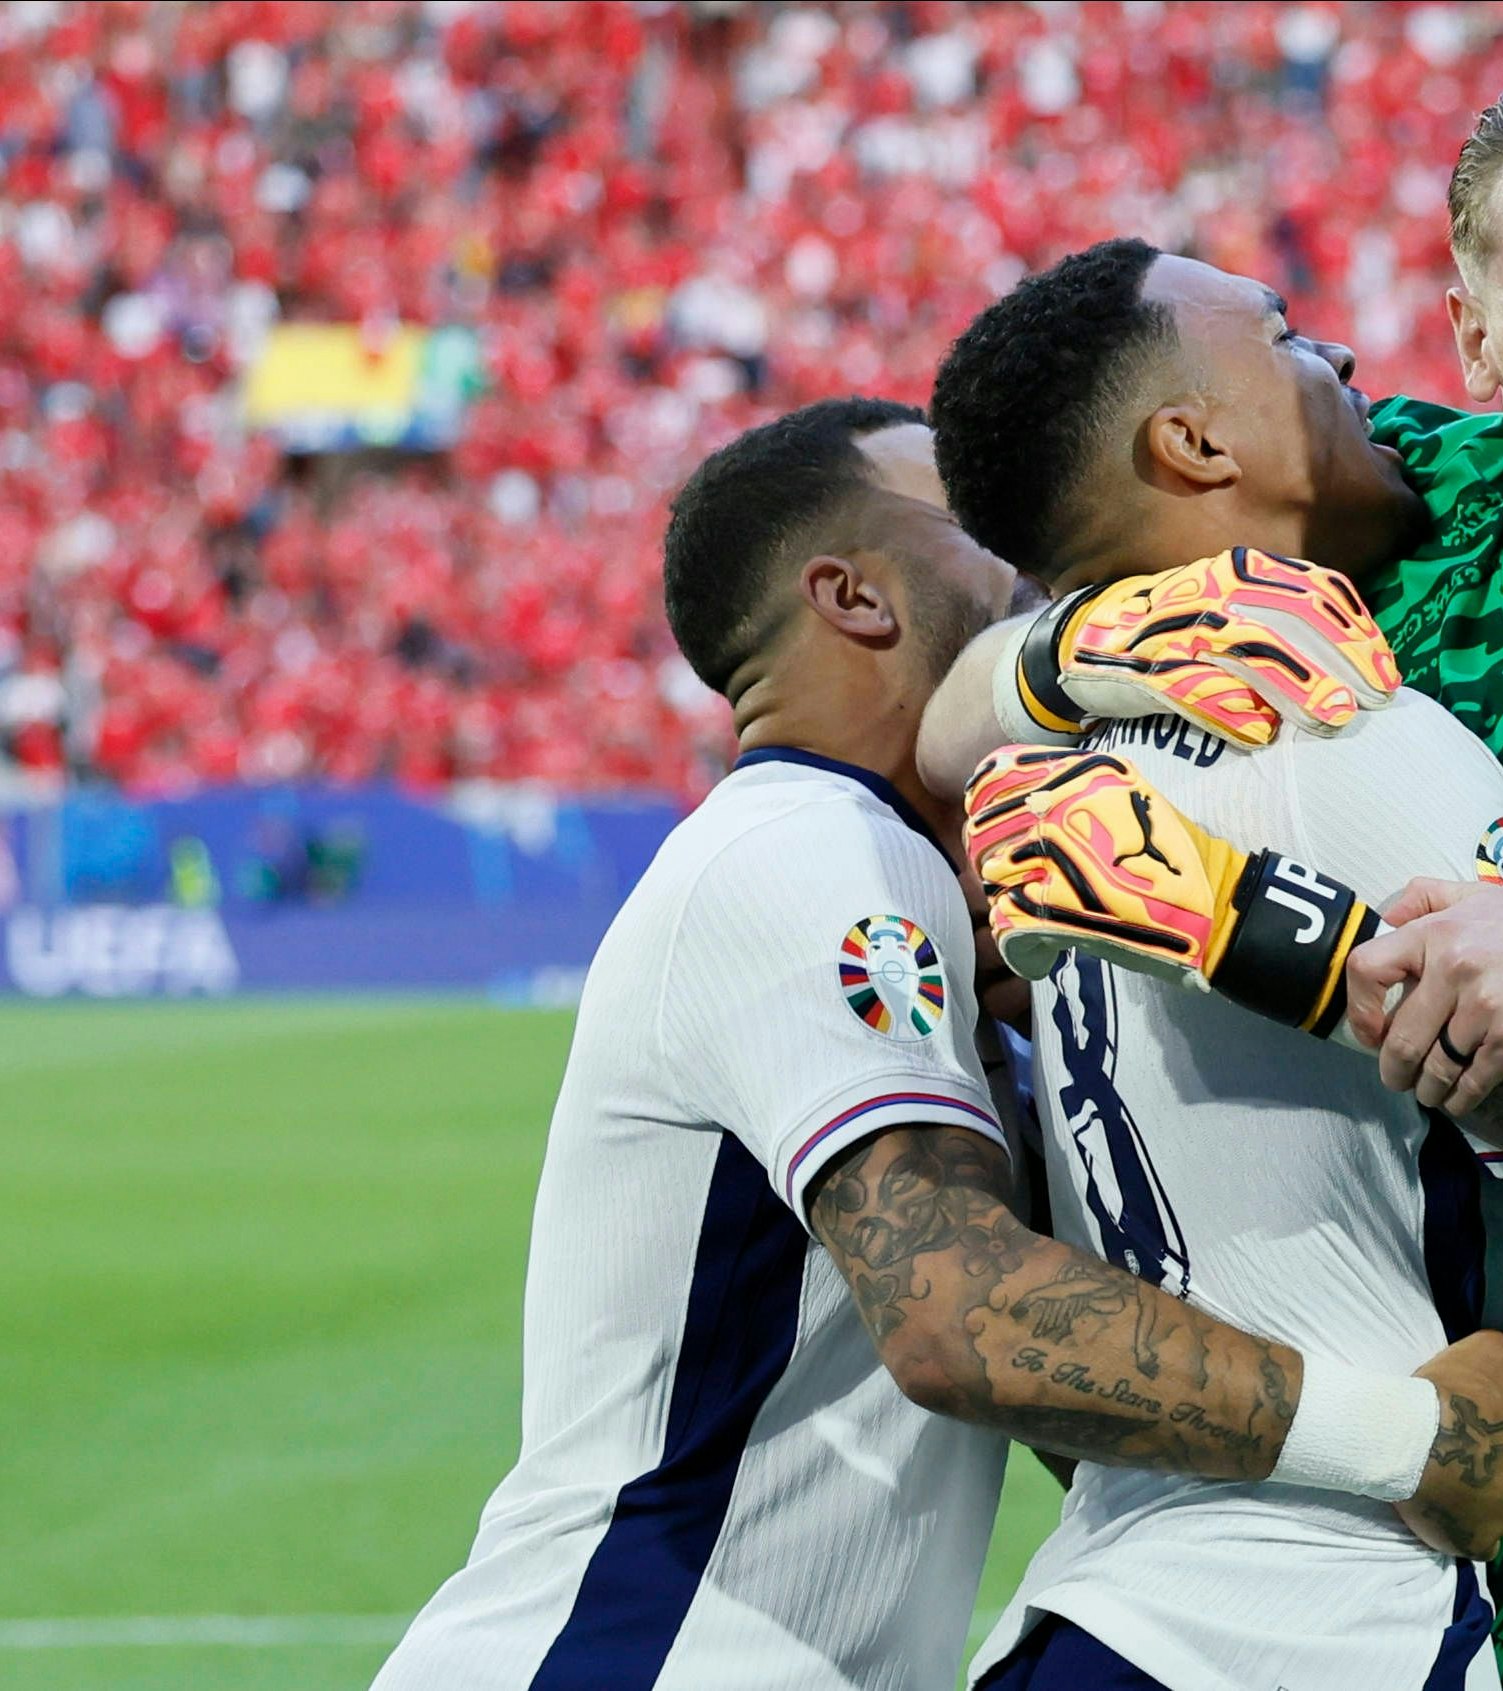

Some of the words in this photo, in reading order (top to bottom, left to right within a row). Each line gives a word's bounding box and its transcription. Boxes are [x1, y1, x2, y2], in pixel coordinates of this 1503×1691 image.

[1264, 856, 1338, 945] JP
[6, 902, 241, 998] UEFA
[1012, 1347, 1048, 1373] To
[1051, 1362, 1095, 1394] The
